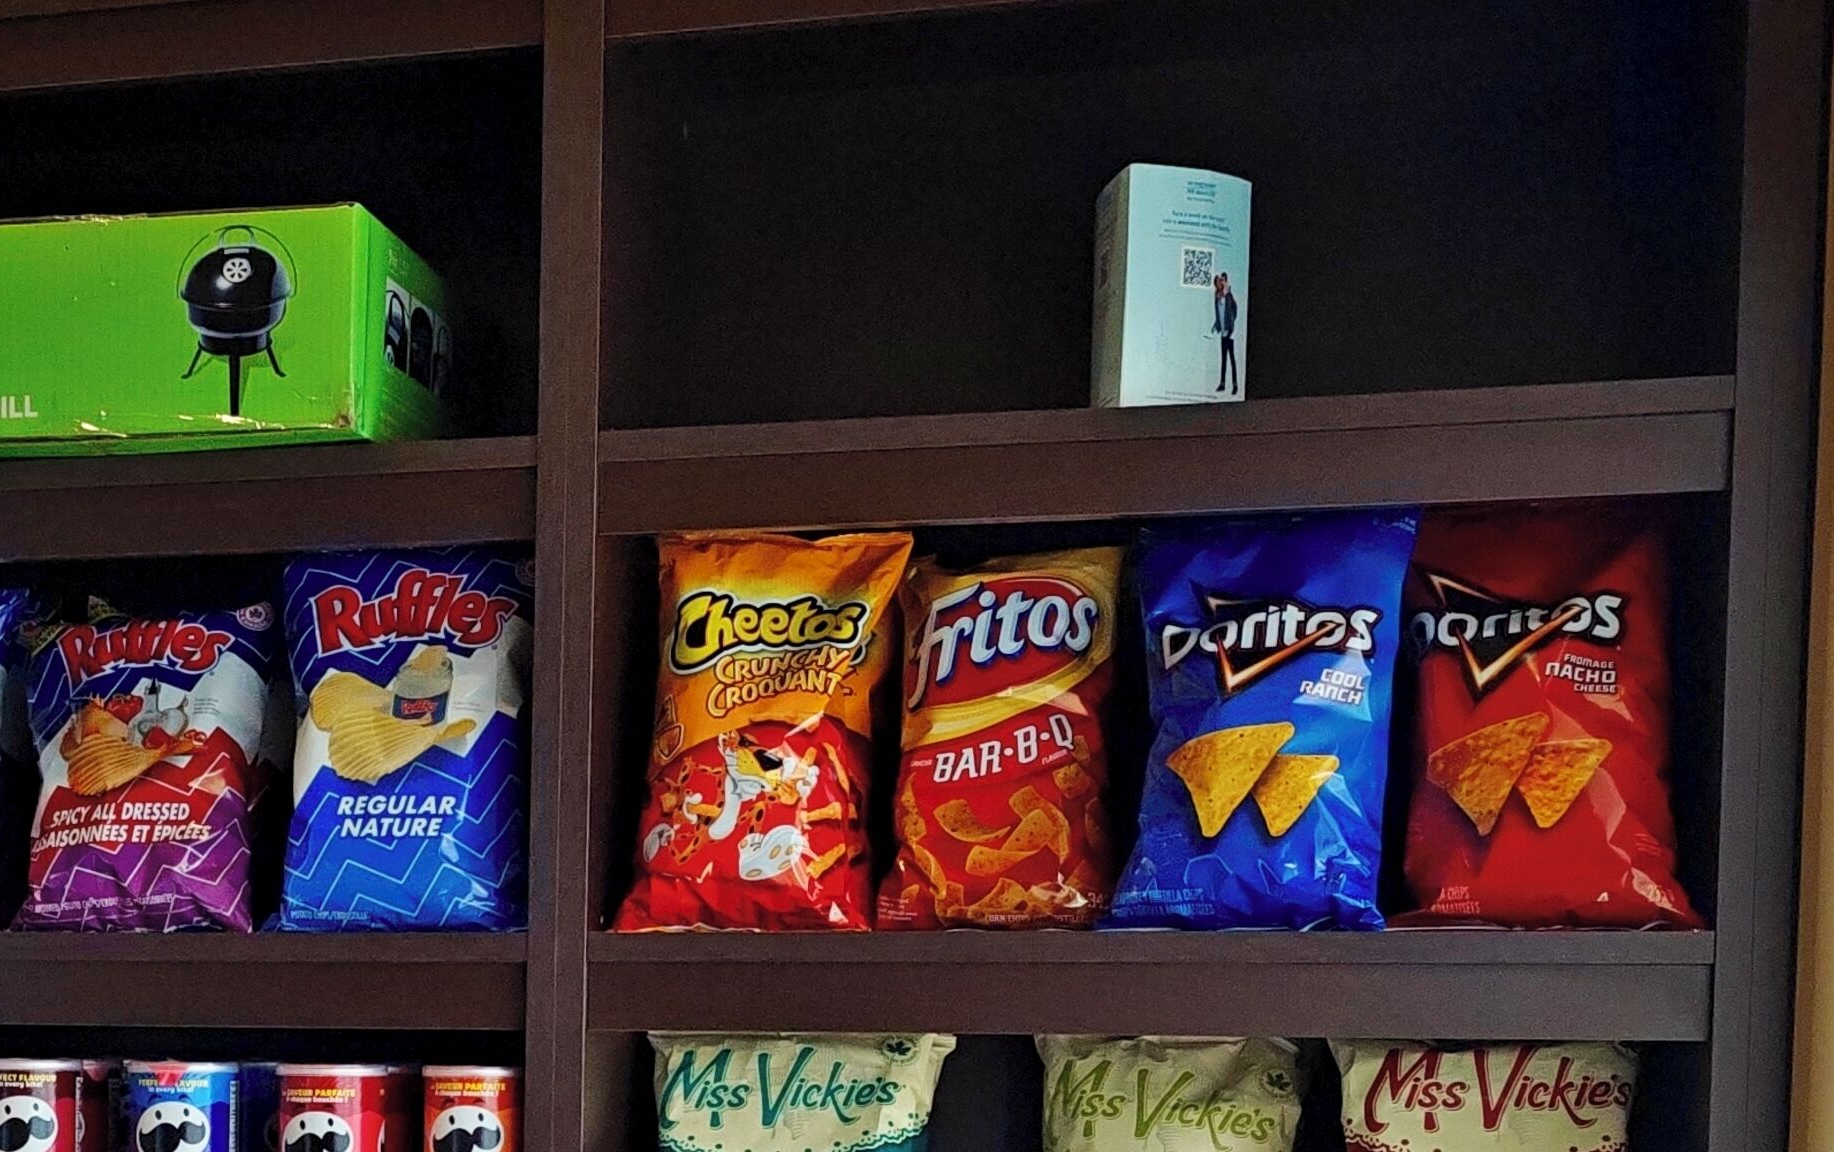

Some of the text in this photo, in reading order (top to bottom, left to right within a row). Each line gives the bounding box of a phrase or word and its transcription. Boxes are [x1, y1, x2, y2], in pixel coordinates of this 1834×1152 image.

[313, 569, 519, 657] Ruffles
[671, 590, 868, 667] Cheetos
[57, 619, 236, 679] Ruffles
[908, 581, 1099, 710] Fritos
[1164, 605, 1379, 668] Doritos
[715, 648, 850, 684] CRUNCHY
[1320, 668, 1364, 691] COOL
[1546, 661, 1616, 683] NACHO
[1564, 654, 1615, 669] FROMAGE
[707, 667, 843, 718] CROQUANT
[1300, 680, 1362, 704] RANCH
[1574, 683, 1616, 693] CHEESE
[51, 802, 190, 825] SPICY ALL DRESSED
[338, 795, 456, 816] REGULAR
[131, 825, 150, 842] ET
[340, 817, 442, 837] NATURE
[659, 1047, 903, 1131] Miss Vickie's
[1048, 1059, 1276, 1152] Miss Vickie's
[1364, 1045, 1631, 1134] Miss Vickie's
